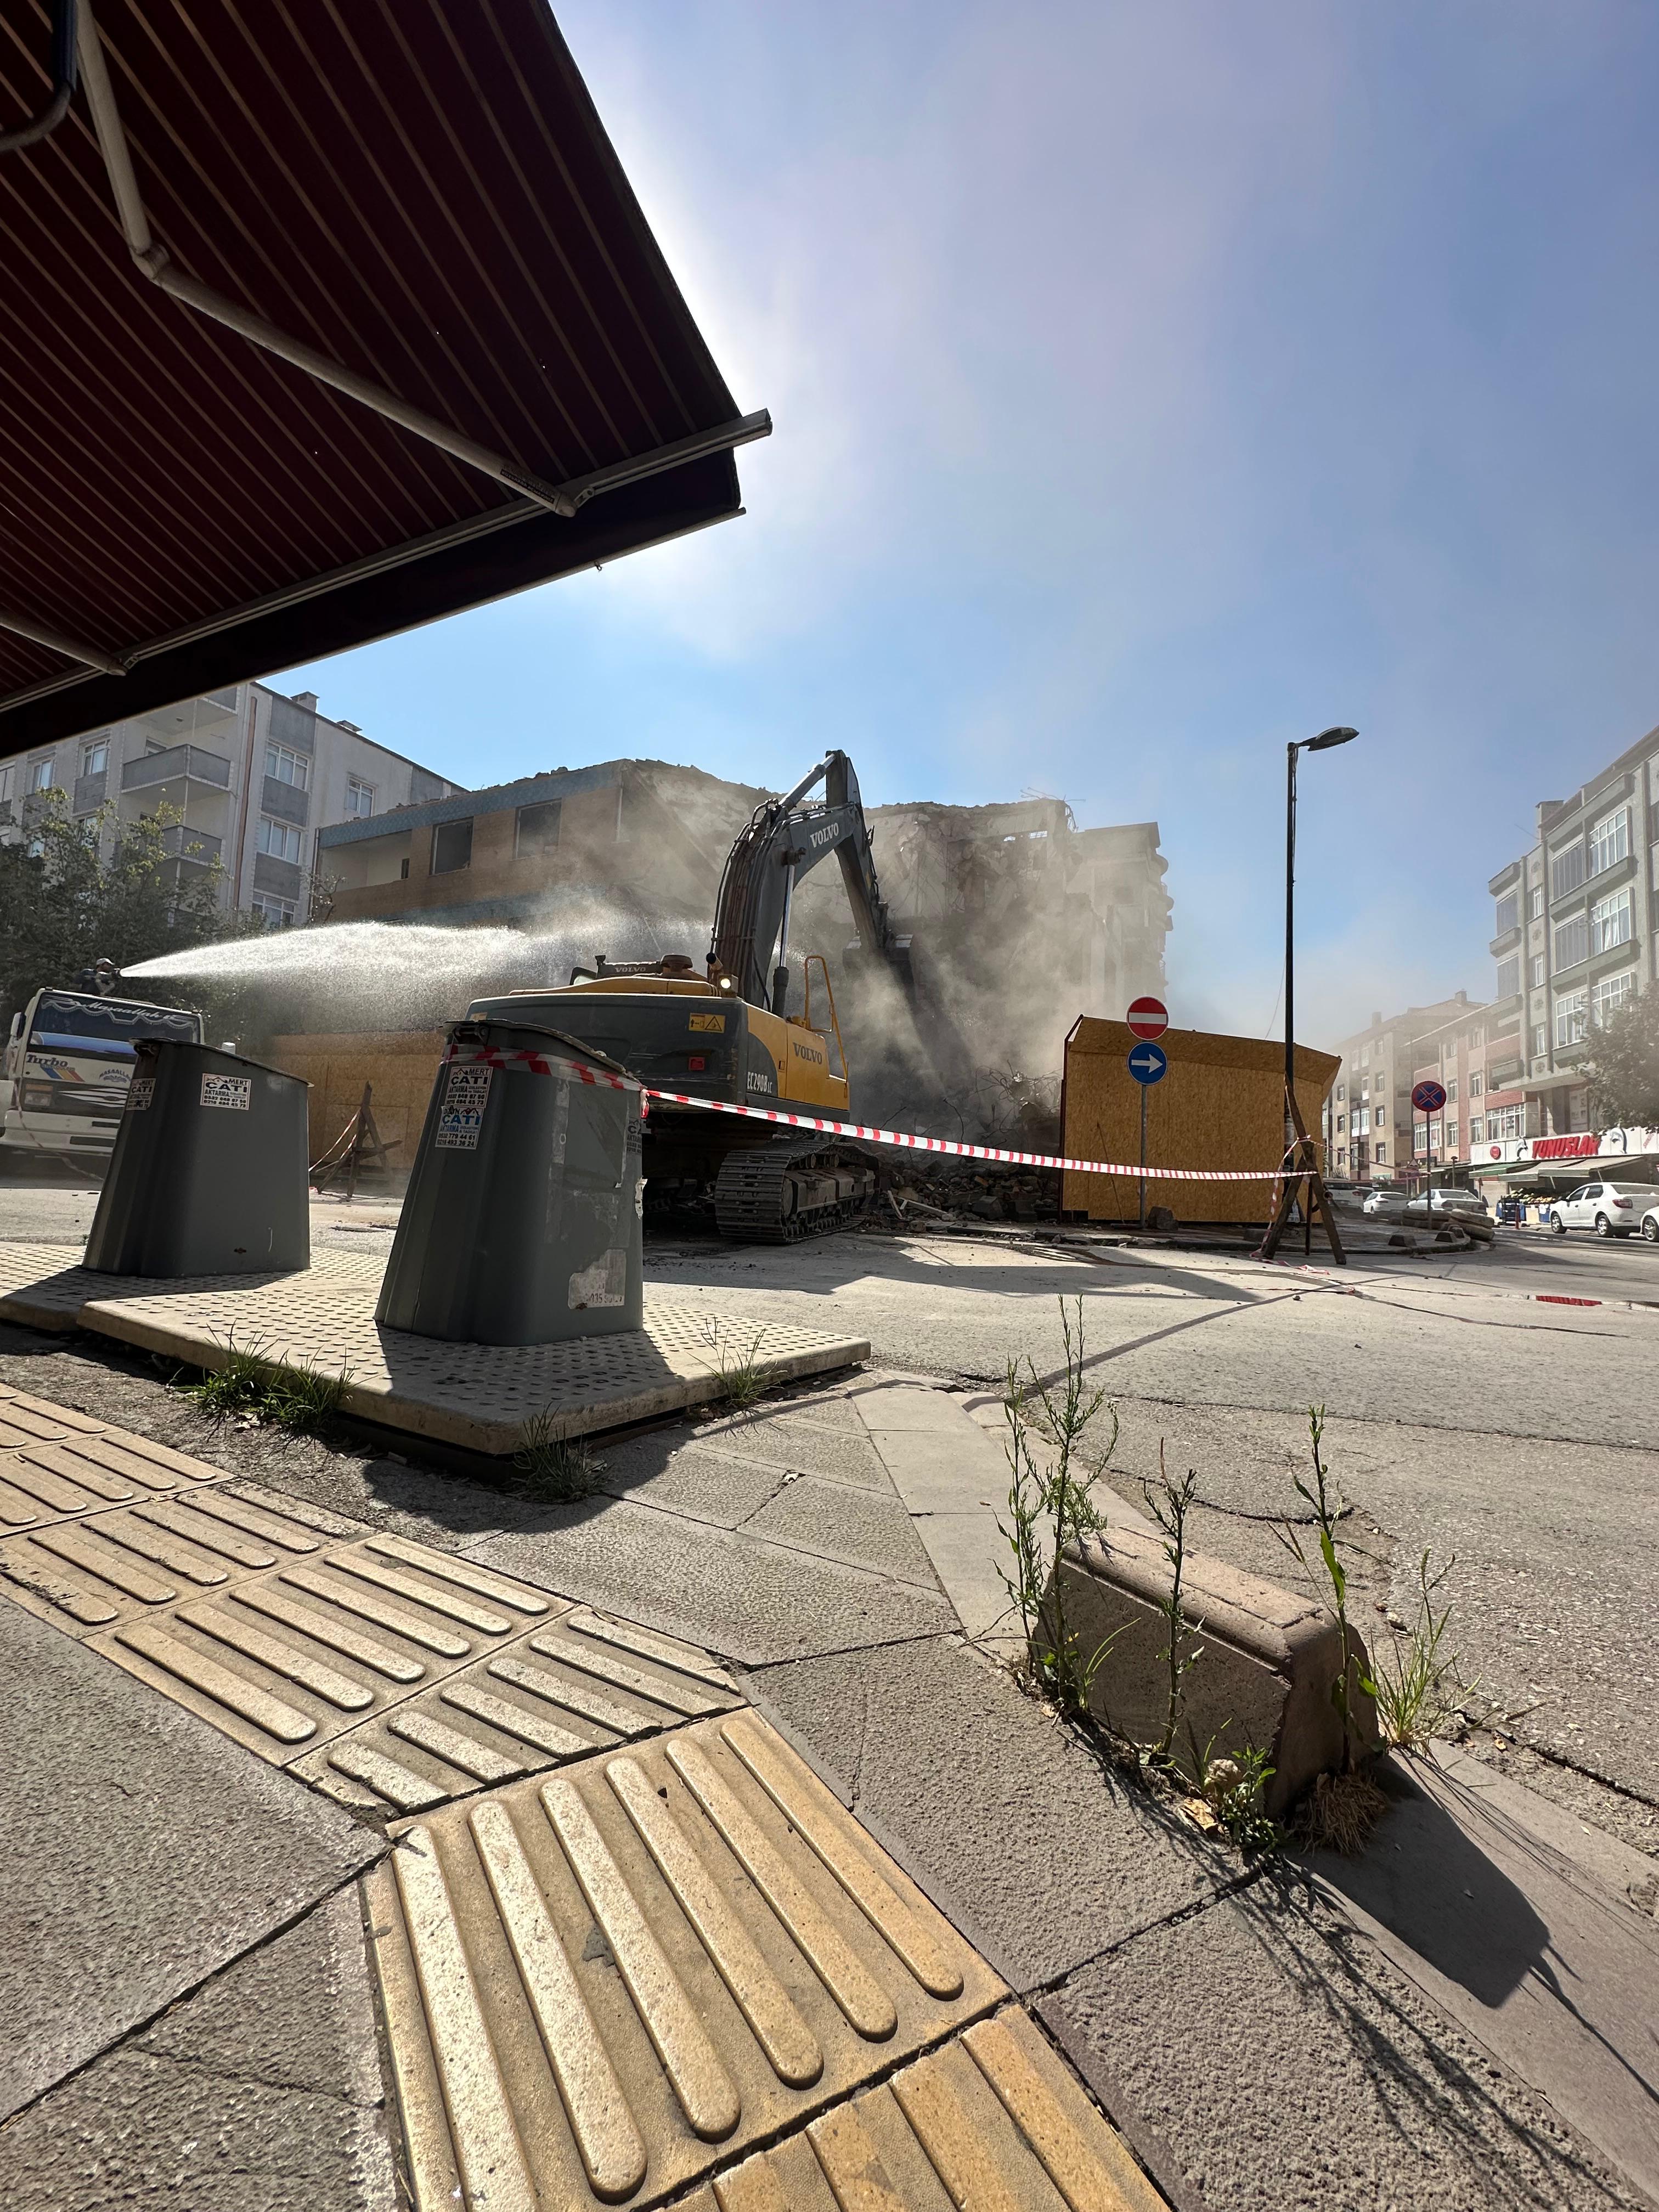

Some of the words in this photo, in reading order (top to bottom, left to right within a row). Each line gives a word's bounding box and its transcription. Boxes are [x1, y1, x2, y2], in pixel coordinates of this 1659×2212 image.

[810, 822, 839, 848] VOLVO
[26, 1054, 69, 1067] Turbo
[793, 1042, 822, 1064] VOLVO
